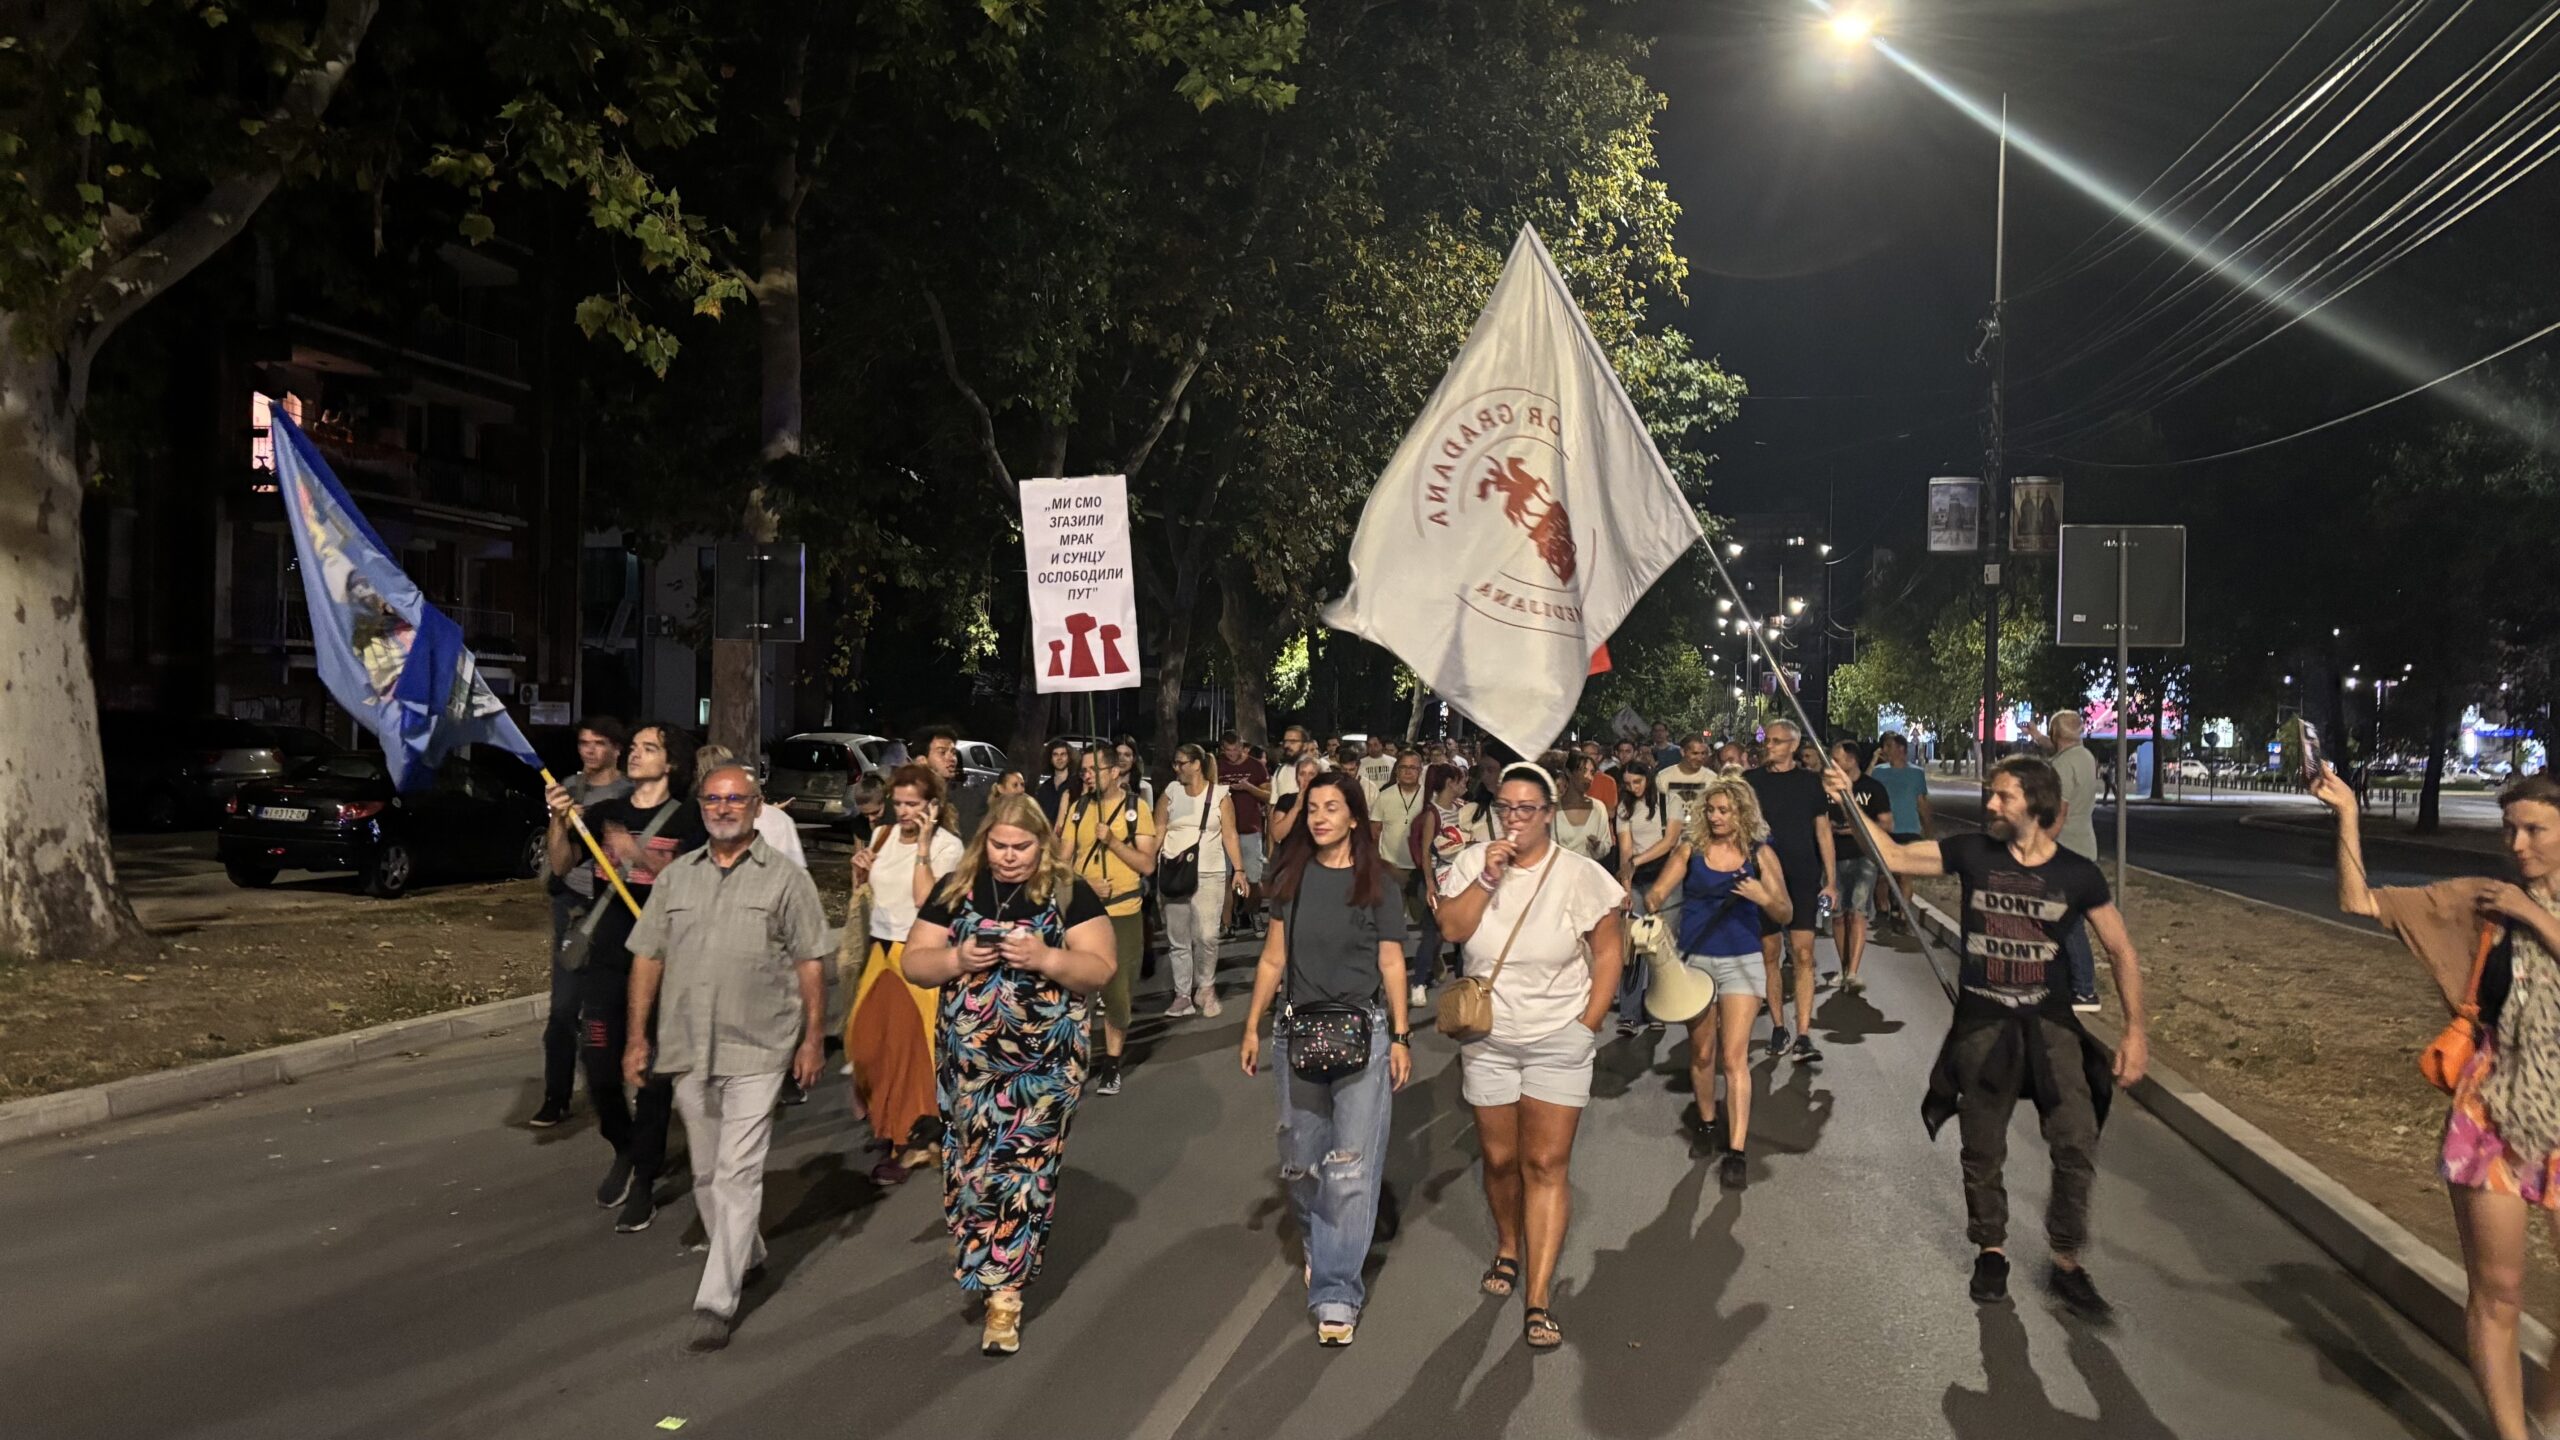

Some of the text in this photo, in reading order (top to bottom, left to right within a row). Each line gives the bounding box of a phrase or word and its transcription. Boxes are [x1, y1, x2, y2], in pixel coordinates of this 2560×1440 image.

[1075, 496, 1102, 509] СМО
[1049, 514, 1104, 528] ЗГАЗИЛИ
[1059, 533, 1094, 546] МРАК
[1051, 551, 1106, 565] И СУНЦУ
[1038, 568, 1123, 584] ОСЛОБОДИЛИ
[1985, 893, 2045, 918] DONT
[1986, 938, 2045, 960] DONT
